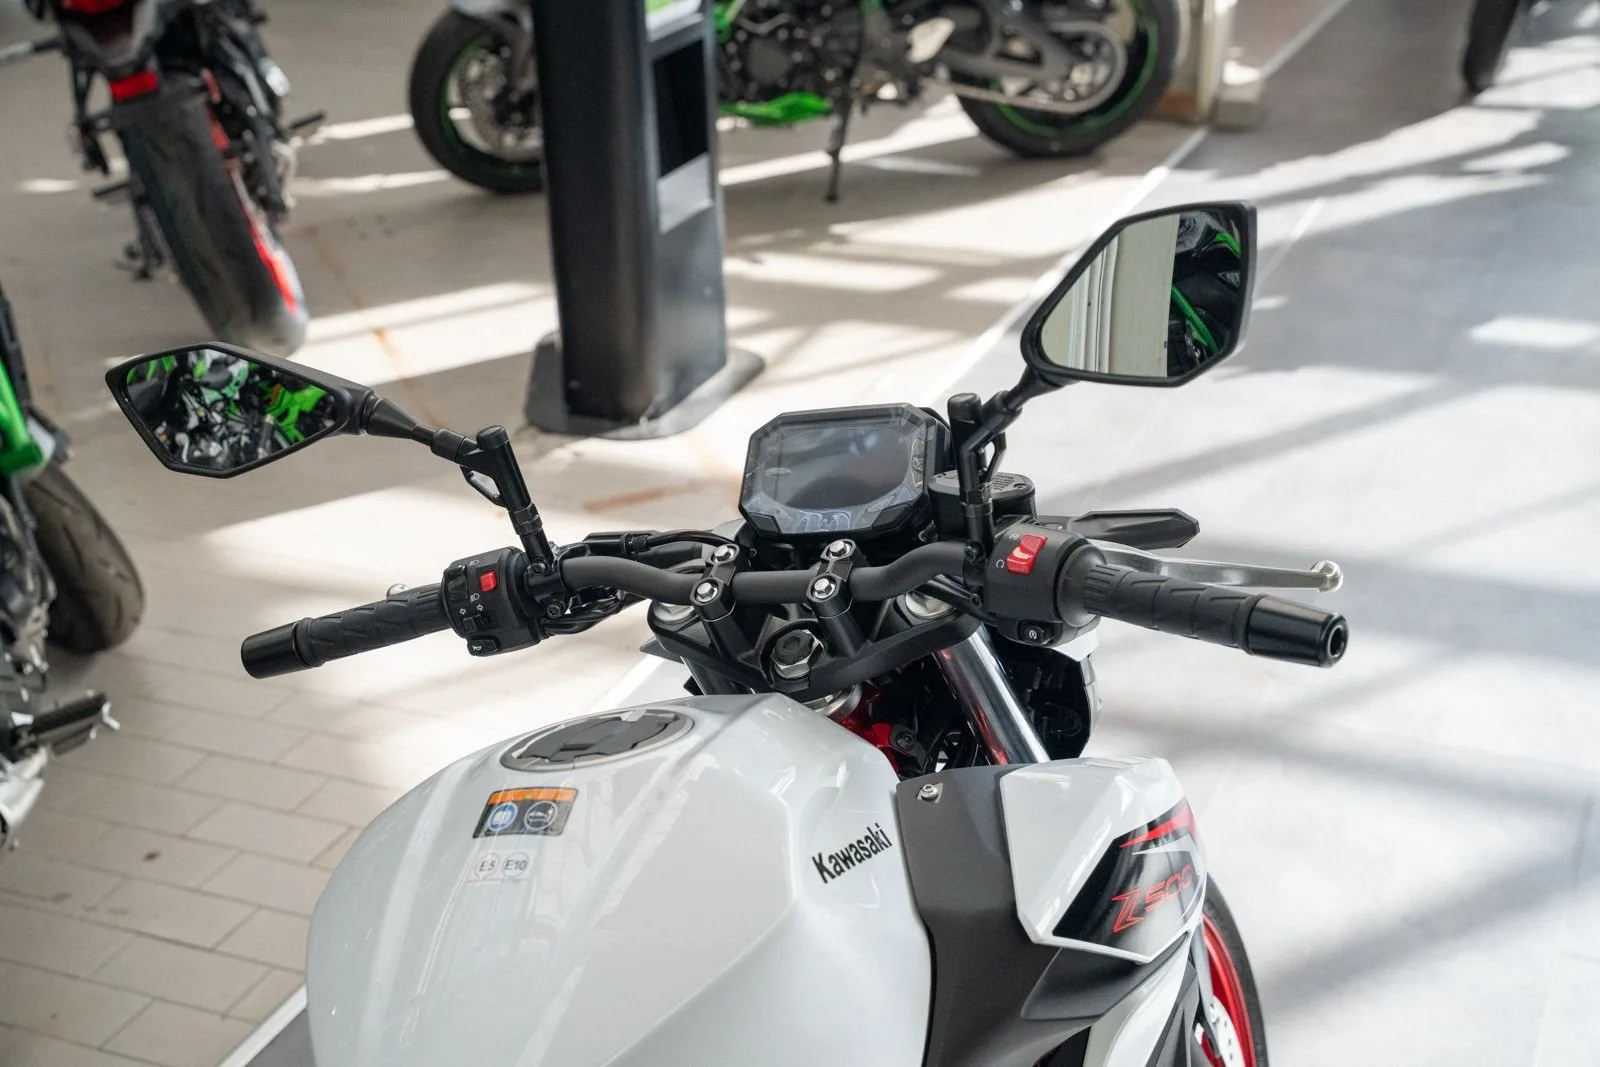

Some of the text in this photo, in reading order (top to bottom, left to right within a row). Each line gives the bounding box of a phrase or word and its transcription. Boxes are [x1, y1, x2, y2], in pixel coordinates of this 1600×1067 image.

[478, 859, 529, 872] E5 E10
[812, 822, 893, 884] Kawasaki
